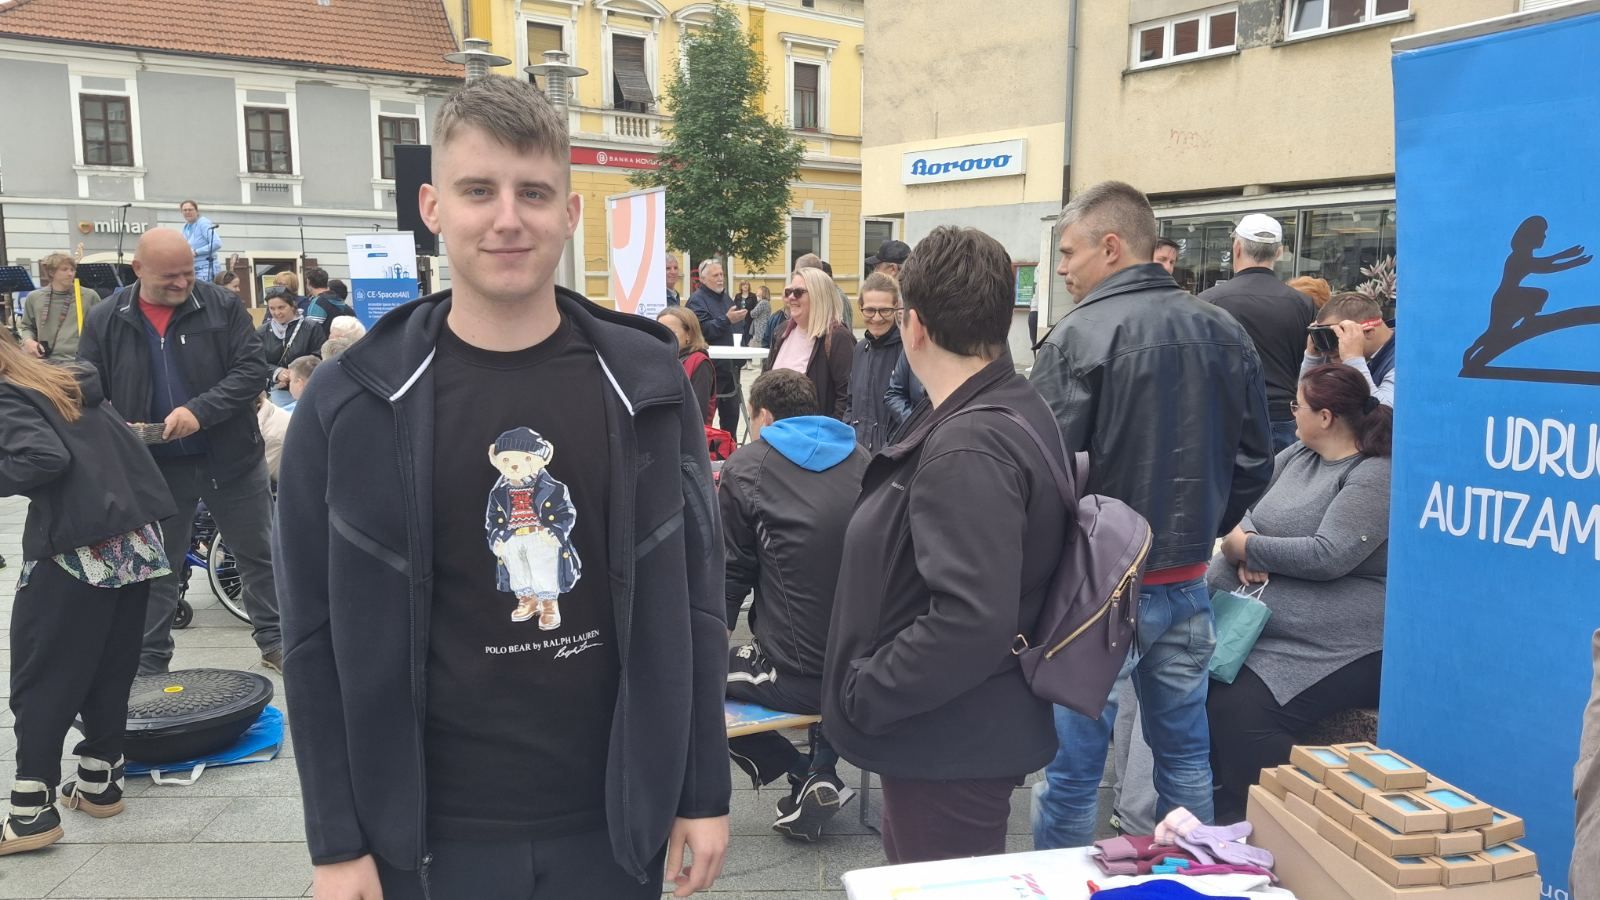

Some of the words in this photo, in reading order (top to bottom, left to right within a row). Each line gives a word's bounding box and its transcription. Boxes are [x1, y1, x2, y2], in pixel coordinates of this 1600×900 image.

[911, 154, 1013, 176] Borovo
[94, 218, 148, 234] mlinar
[1485, 416, 1600, 479] UDRU
[1419, 481, 1600, 561] AUTIZAM
[485, 645, 507, 655] POLO
[508, 643, 531, 654] BEAR
[533, 642, 541, 651] by
[543, 636, 571, 648] RALPH
[573, 629, 600, 643] LAUREN
